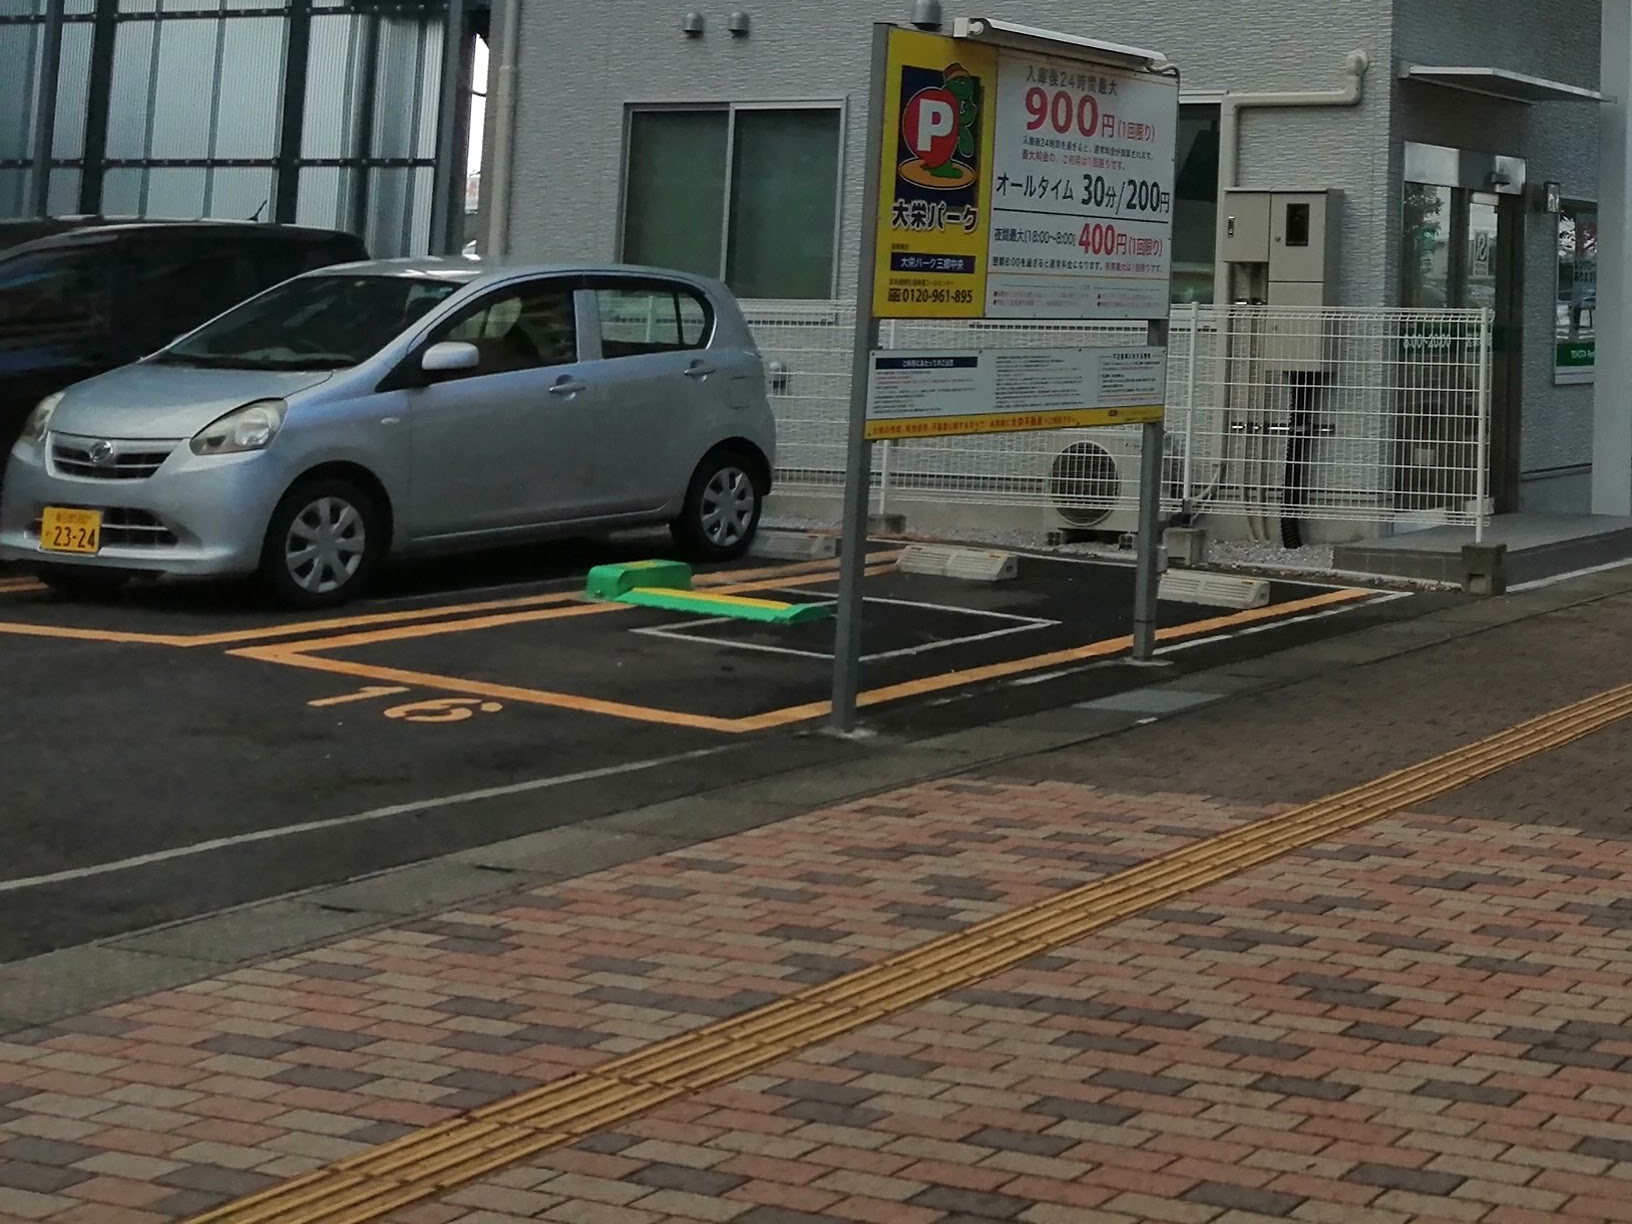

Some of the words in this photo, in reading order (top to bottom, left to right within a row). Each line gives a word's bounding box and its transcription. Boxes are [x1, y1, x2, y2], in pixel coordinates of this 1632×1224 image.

[916, 98, 954, 152] P
[996, 172, 1075, 201] オールタイム
[892, 199, 978, 232] 大栄パーク
[902, 287, 973, 304] 0120-961-895
[53, 526, 96, 548] 23-24
